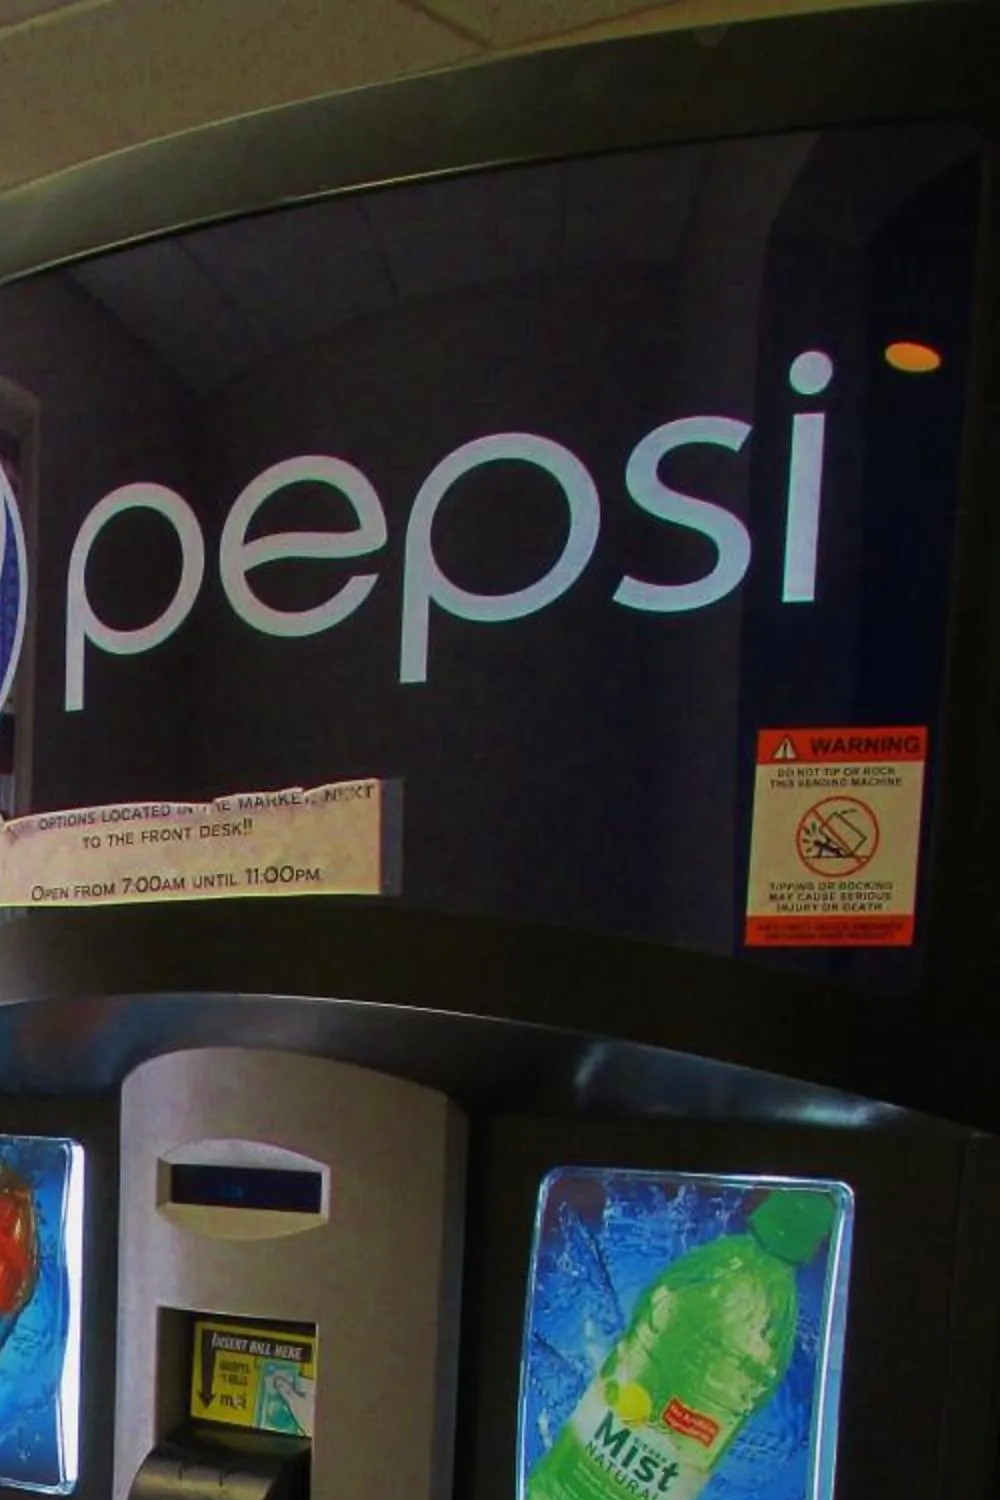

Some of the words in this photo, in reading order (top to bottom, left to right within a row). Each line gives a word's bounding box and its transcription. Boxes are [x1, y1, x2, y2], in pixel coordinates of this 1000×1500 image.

[65, 350, 833, 711] pepsi
[811, 735, 920, 756] WARNING
[38, 812, 95, 830] OPTIONS
[101, 805, 171, 823] LOCATED
[82, 836, 101, 849] TO
[107, 832, 134, 847] THE
[141, 827, 193, 843] FRONT
[199, 818, 253, 839] DESK!!
[30, 885, 69, 901] OPEN
[74, 881, 115, 897] FROM
[194, 873, 238, 888] UNTIL
[593, 1409, 680, 1492] Mist
